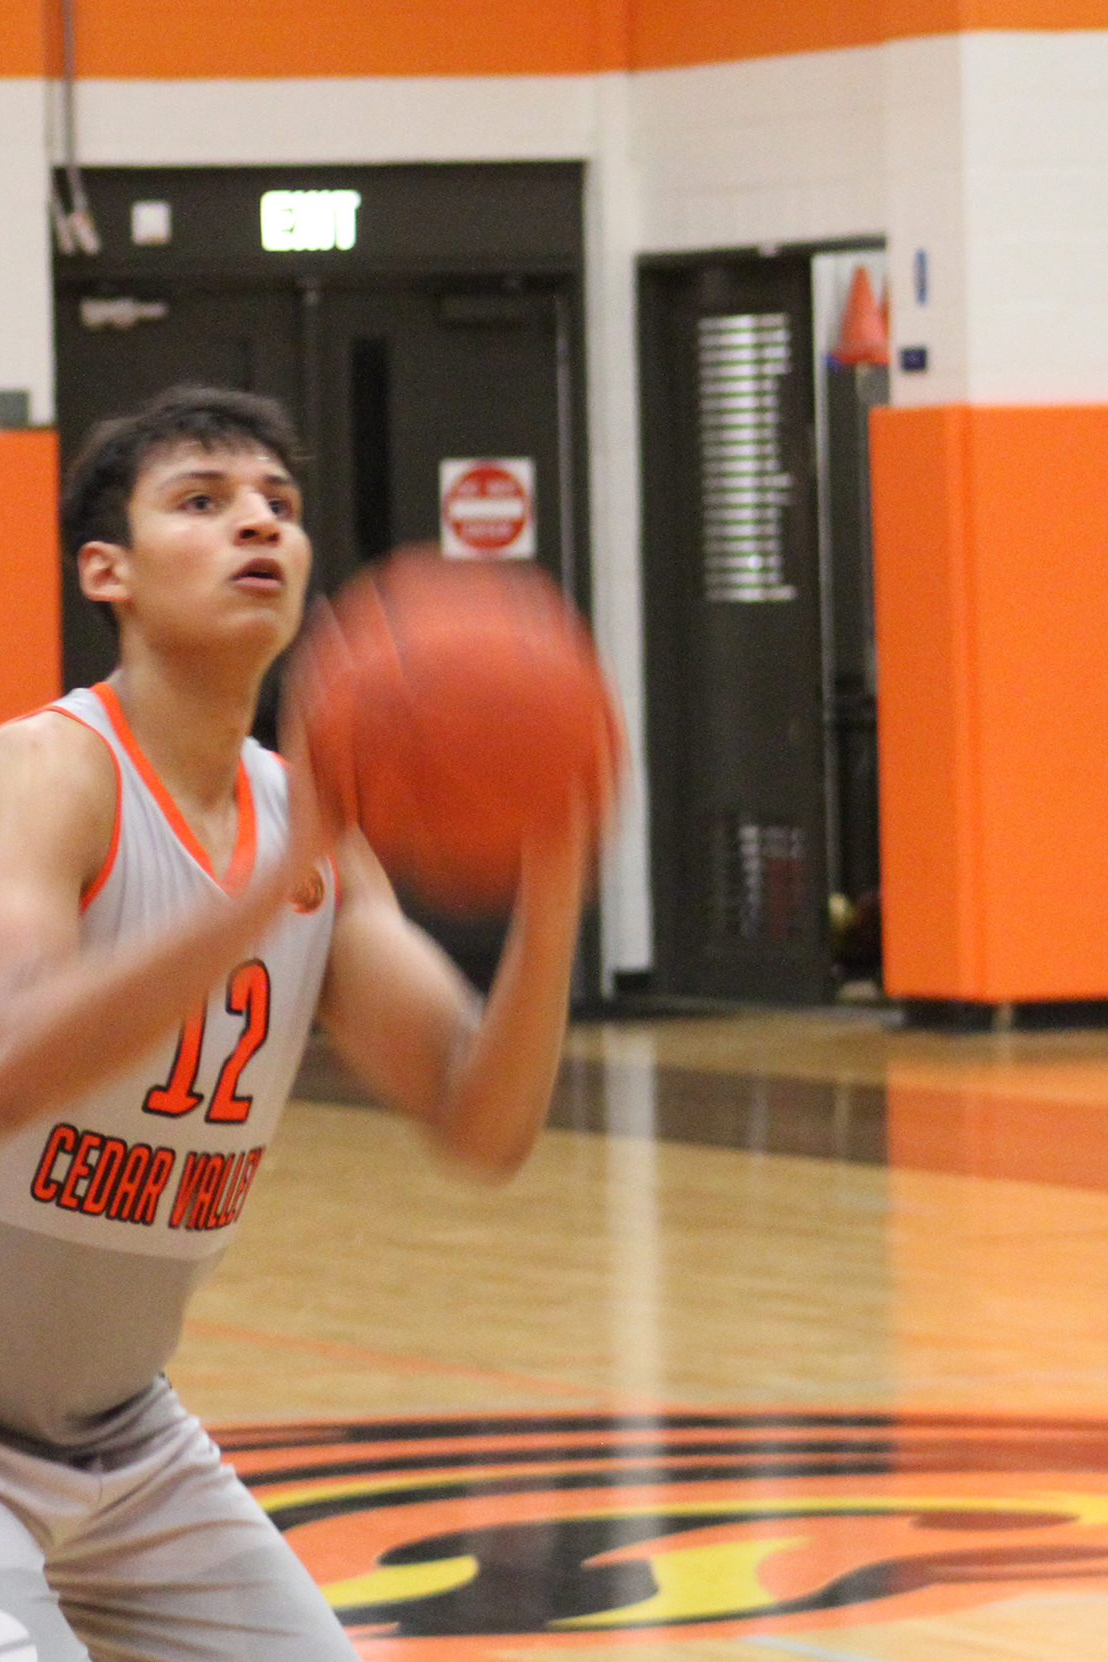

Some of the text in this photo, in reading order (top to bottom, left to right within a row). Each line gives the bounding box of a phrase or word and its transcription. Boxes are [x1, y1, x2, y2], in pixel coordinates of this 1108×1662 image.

[142, 958, 270, 1124] 12
[30, 1123, 266, 1231] CEDAR VALLE
